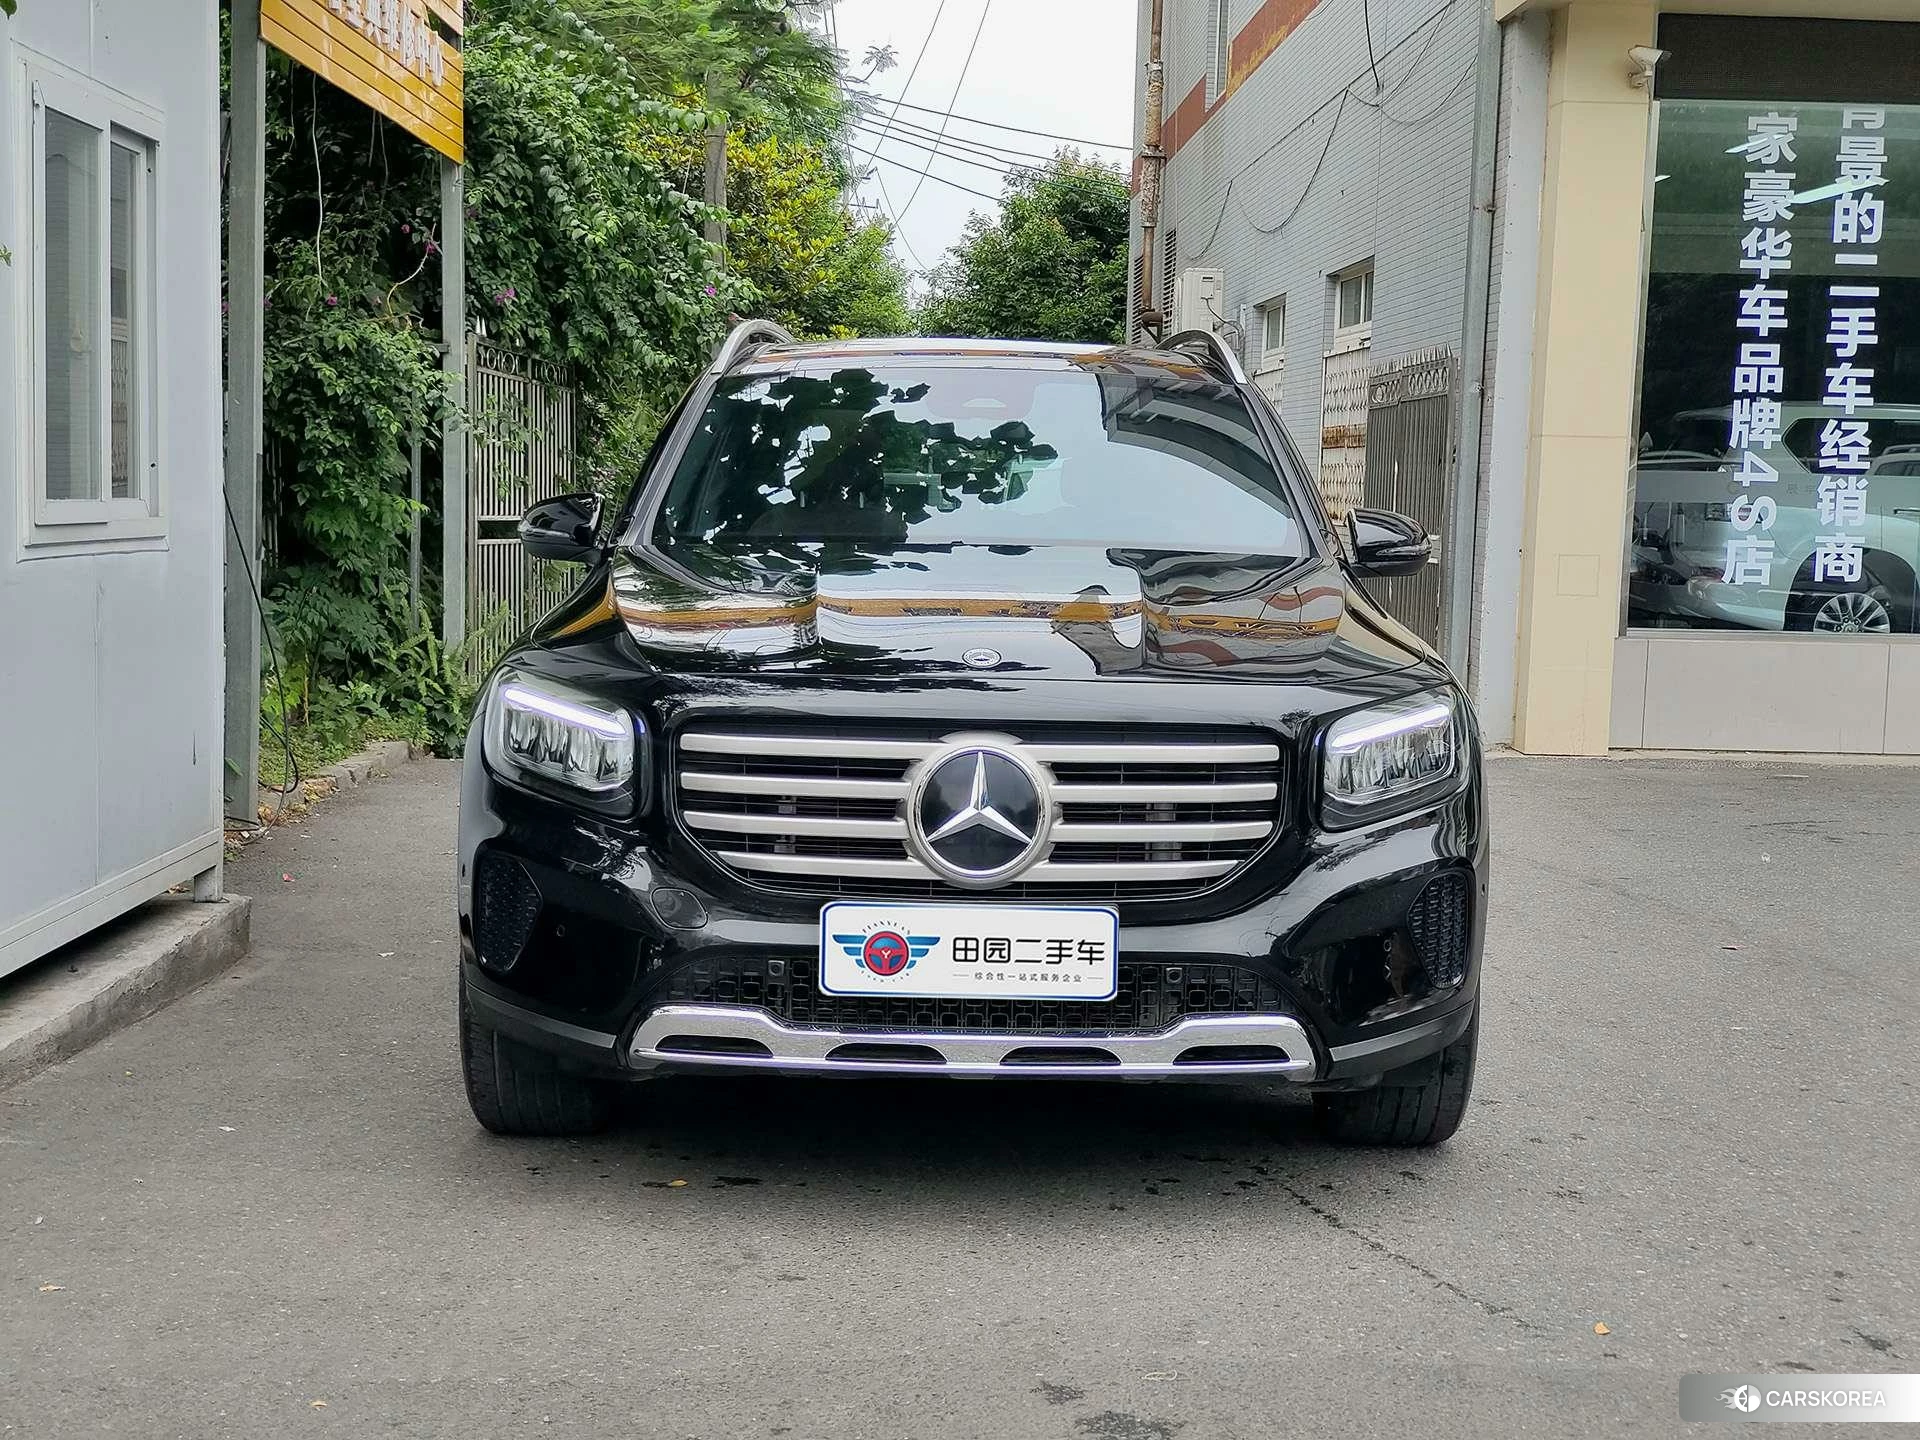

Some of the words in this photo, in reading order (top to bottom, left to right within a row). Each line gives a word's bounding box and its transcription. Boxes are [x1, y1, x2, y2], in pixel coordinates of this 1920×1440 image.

[1721, 111, 1798, 587] 家豪华车品牌4S店
[953, 937, 1105, 965] 田园二手车
